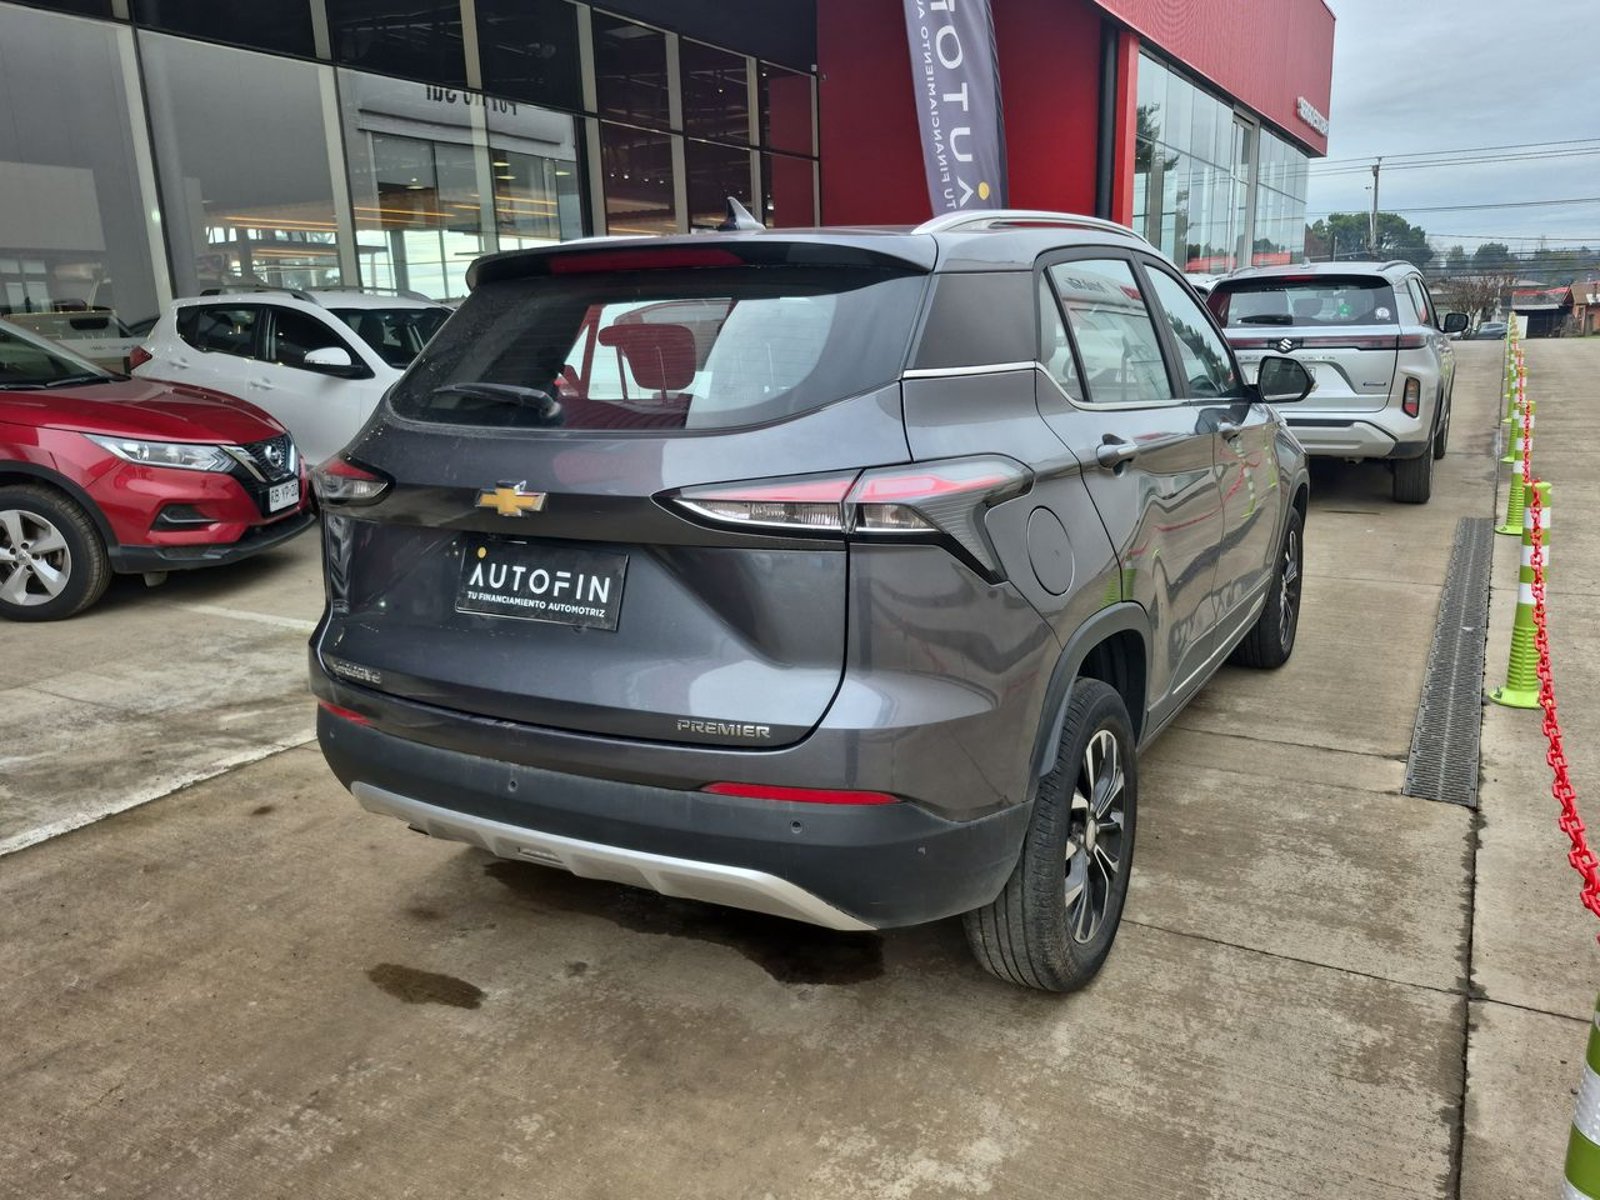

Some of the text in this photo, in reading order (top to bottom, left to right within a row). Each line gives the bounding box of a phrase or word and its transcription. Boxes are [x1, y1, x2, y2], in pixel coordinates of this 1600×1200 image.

[469, 562, 611, 604] AUTOFIN
[467, 591, 606, 618] TU FINANCIAMIENTO AUTOMOTRIZ
[676, 719, 771, 738] PREMIER
